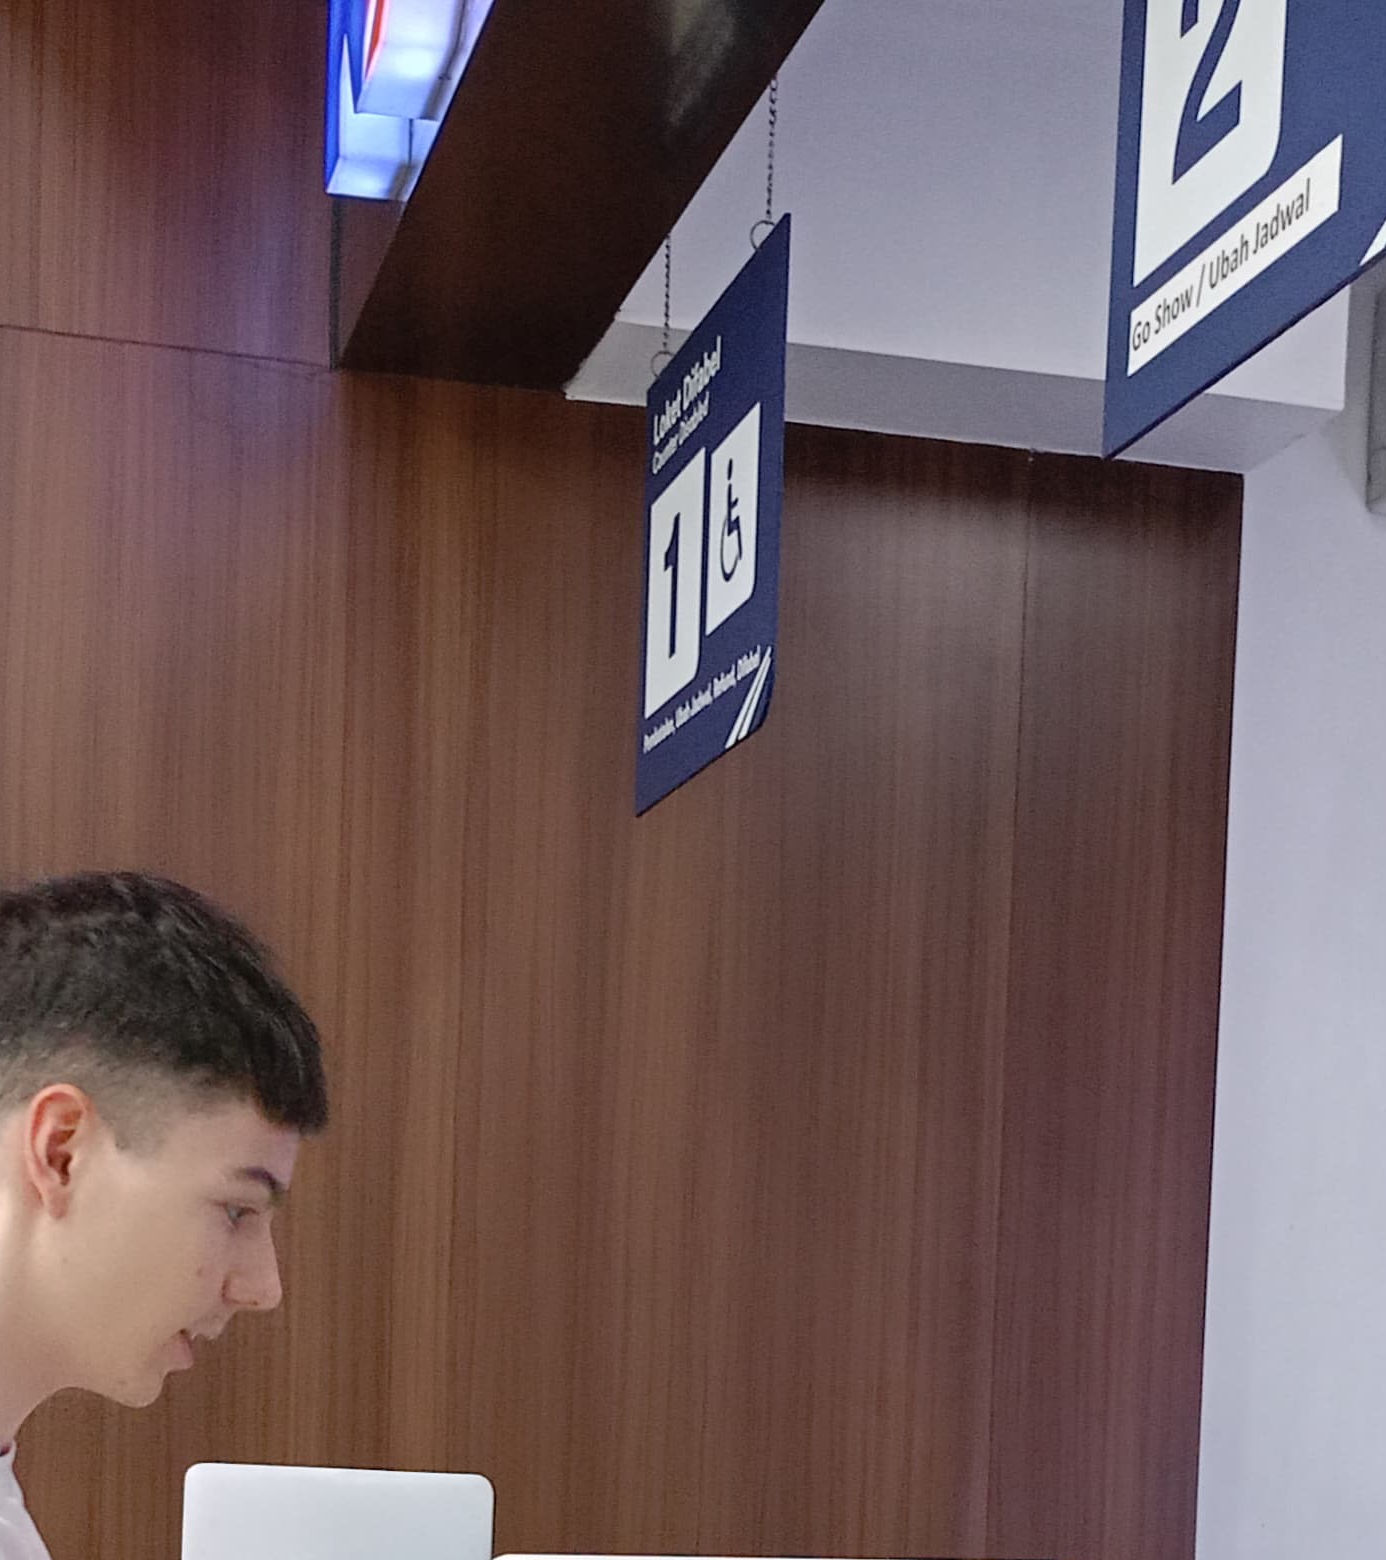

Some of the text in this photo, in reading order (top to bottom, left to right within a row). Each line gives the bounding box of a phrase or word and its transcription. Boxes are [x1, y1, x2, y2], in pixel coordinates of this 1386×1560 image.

[1131, 177, 1311, 351] Go Show / Ubah Jadwal
[653, 388, 681, 446] Loket
[663, 511, 682, 659] 1
